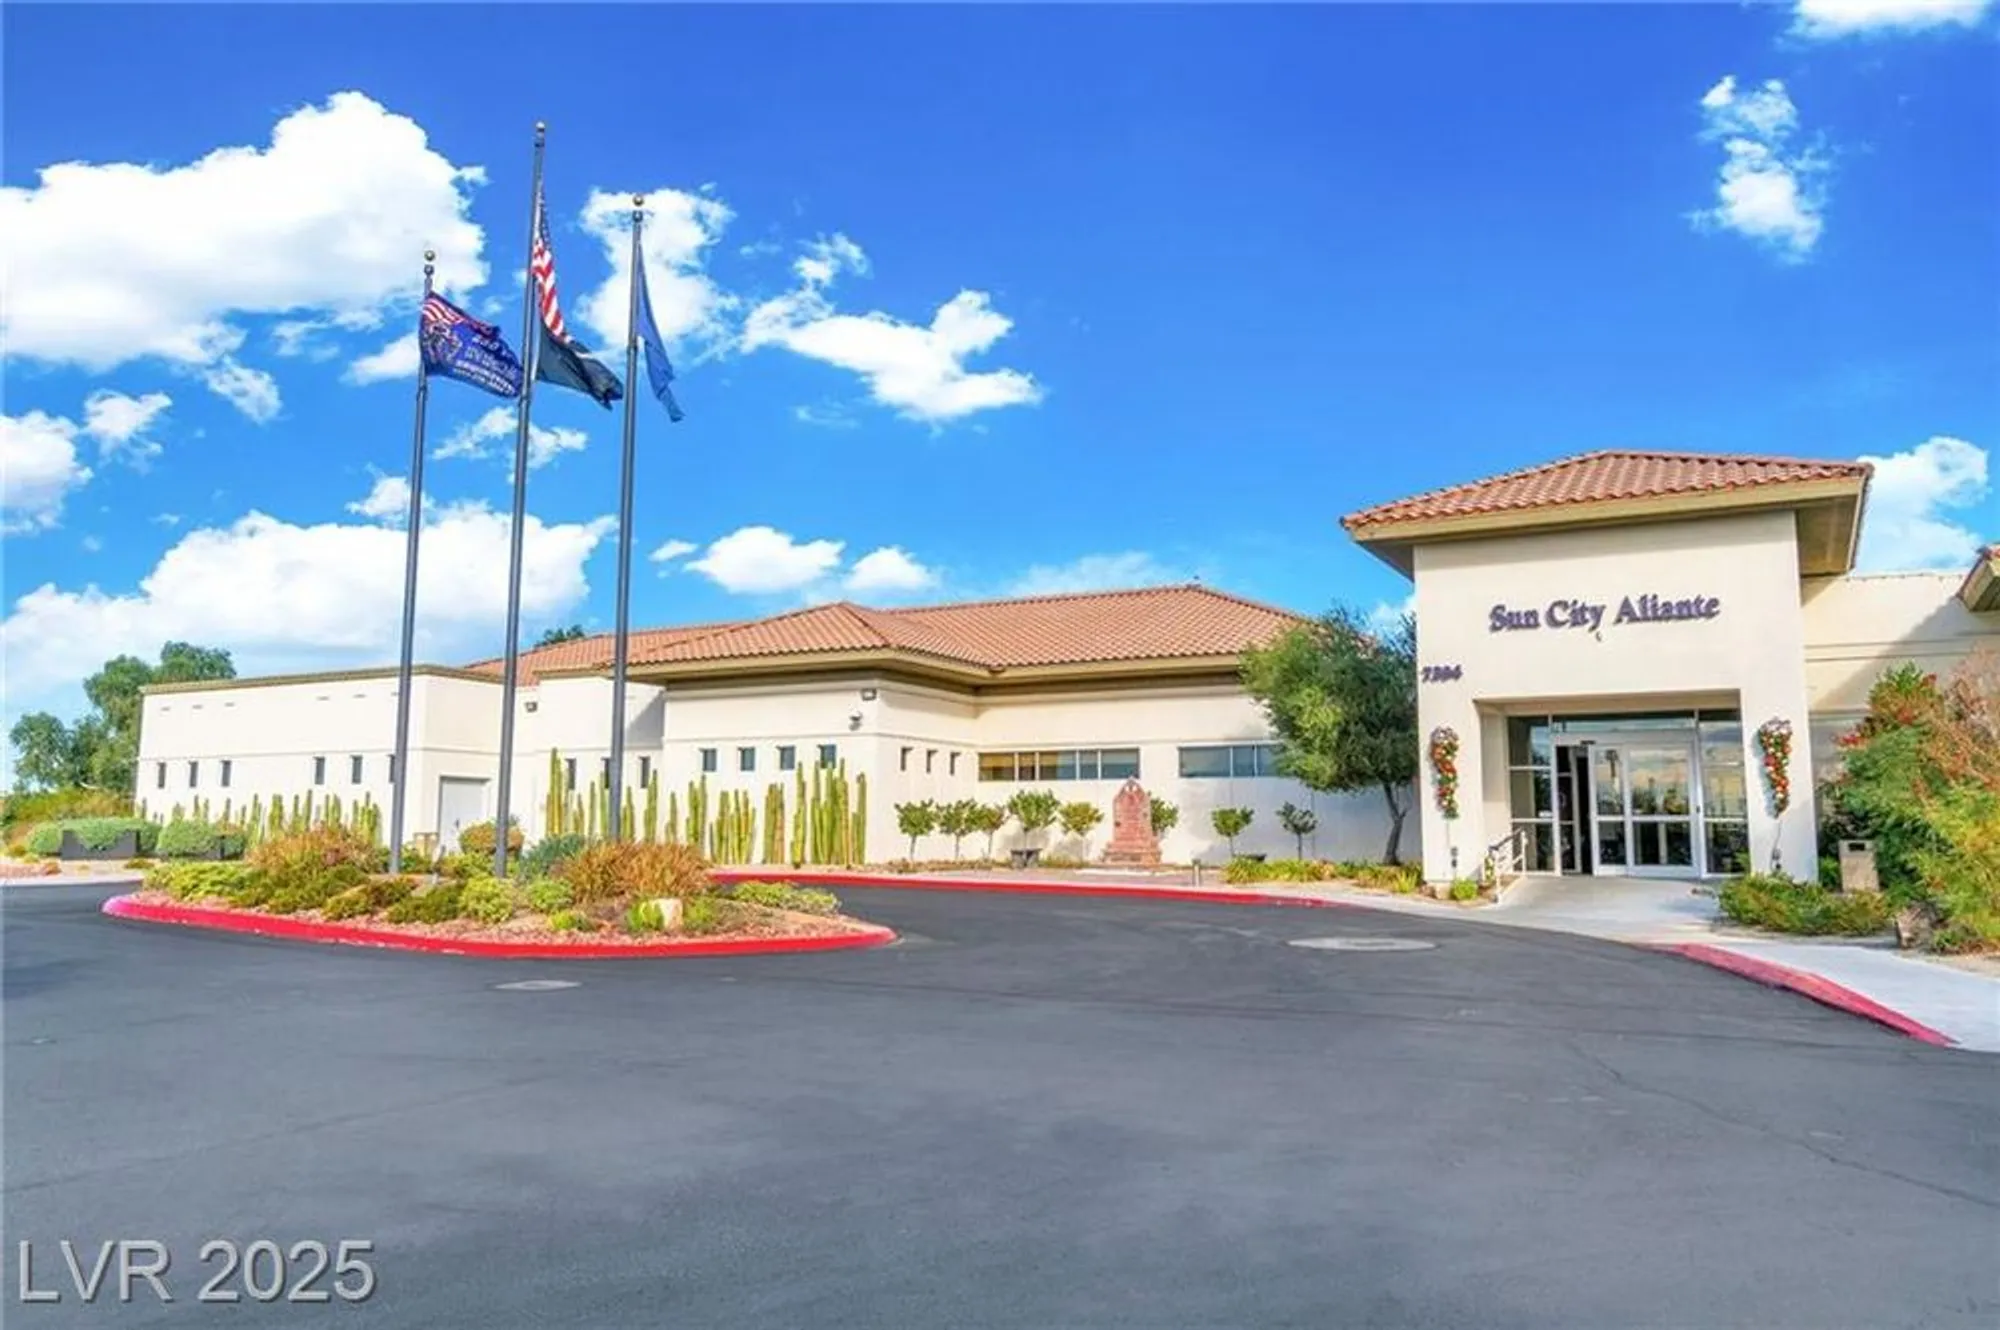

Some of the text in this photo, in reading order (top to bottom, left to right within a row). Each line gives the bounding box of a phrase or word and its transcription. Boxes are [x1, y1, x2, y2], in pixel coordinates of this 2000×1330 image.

[1490, 594, 1721, 632] Sun City Aliante
